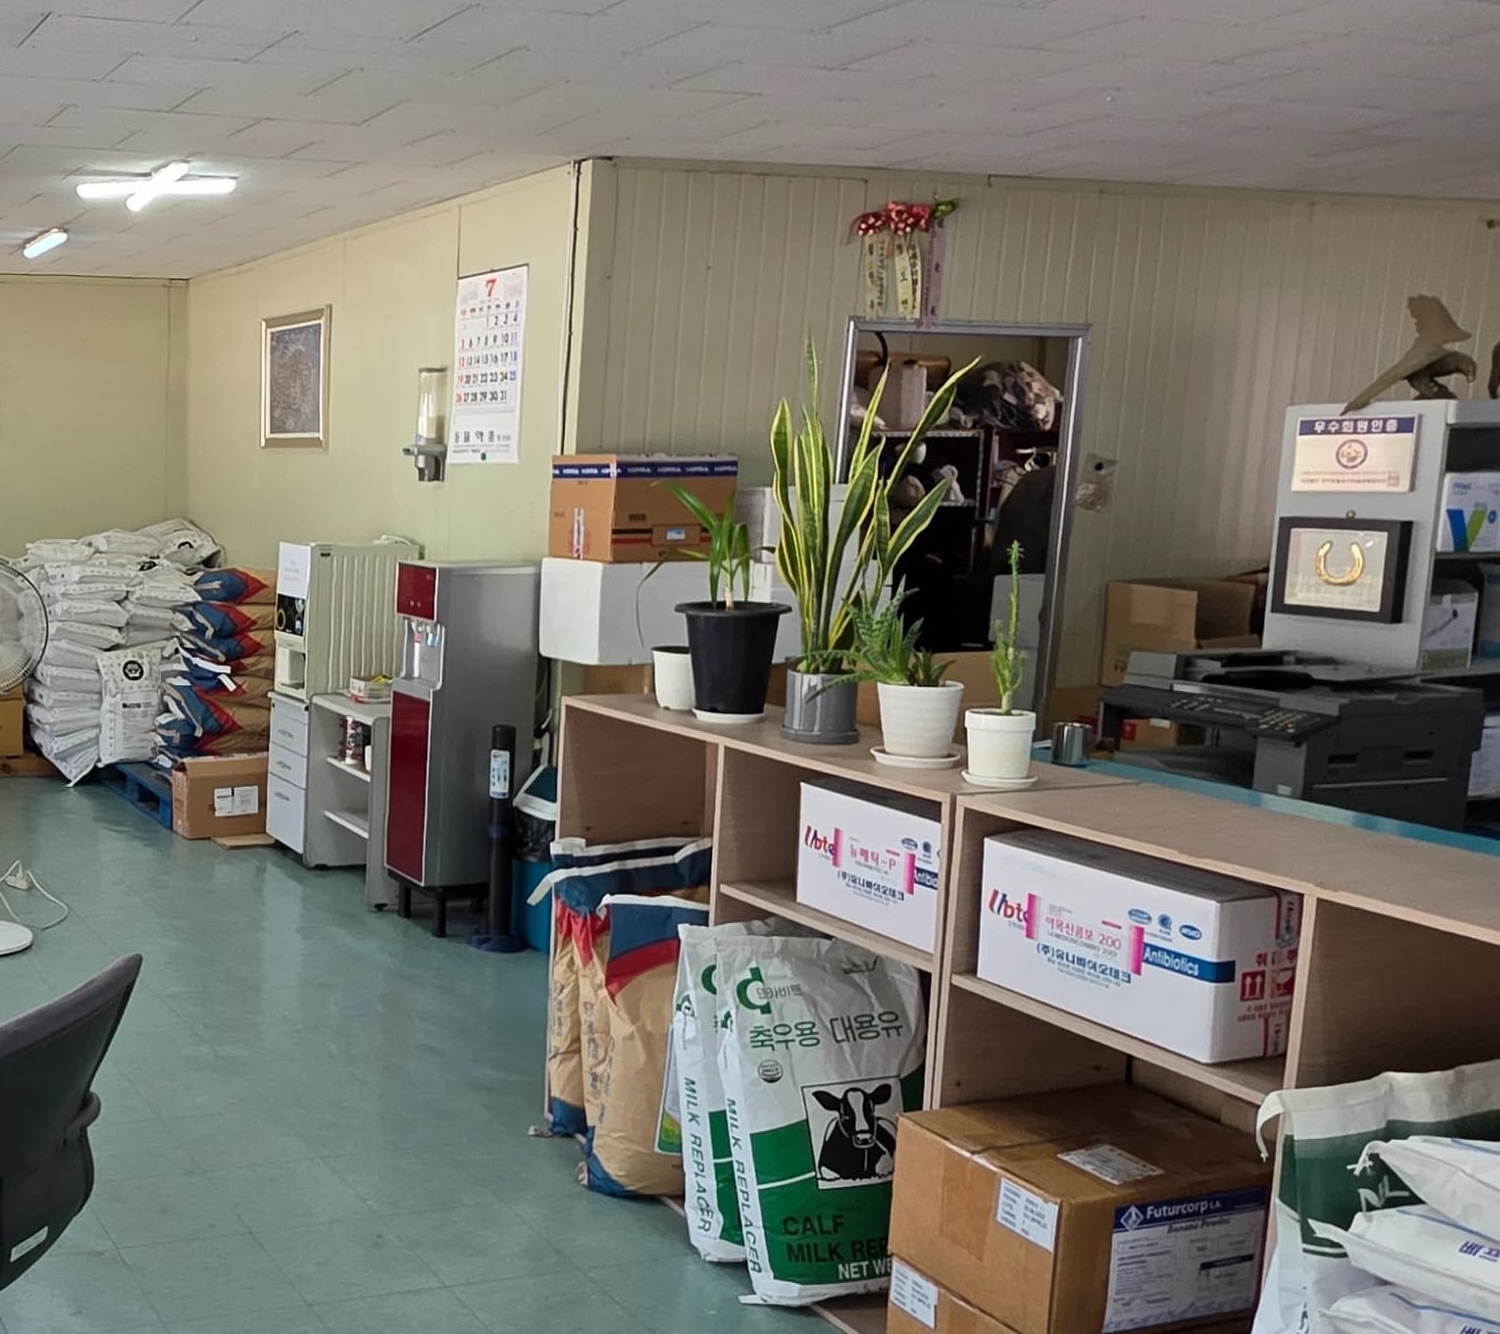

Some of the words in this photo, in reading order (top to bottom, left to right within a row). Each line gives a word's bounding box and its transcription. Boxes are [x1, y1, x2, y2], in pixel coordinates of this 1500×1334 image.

[485, 278, 497, 297] 7
[1099, 933, 1122, 950] 200
[1036, 942, 1132, 984] (주)유니바이오테크
[1143, 946, 1200, 976] Antibiotics
[749, 1020, 821, 1052] 축우용
[829, 1010, 904, 1045] 대용유
[683, 1076, 700, 1124] MILK
[726, 1097, 743, 1150] MILK
[690, 1133, 713, 1233] REPLACER
[734, 1159, 763, 1275] REPLACER
[782, 1213, 845, 1236] CALF
[1146, 1200, 1208, 1220] Futurcorp
[786, 1239, 840, 1264] MILK
[838, 1261, 870, 1281] NET
